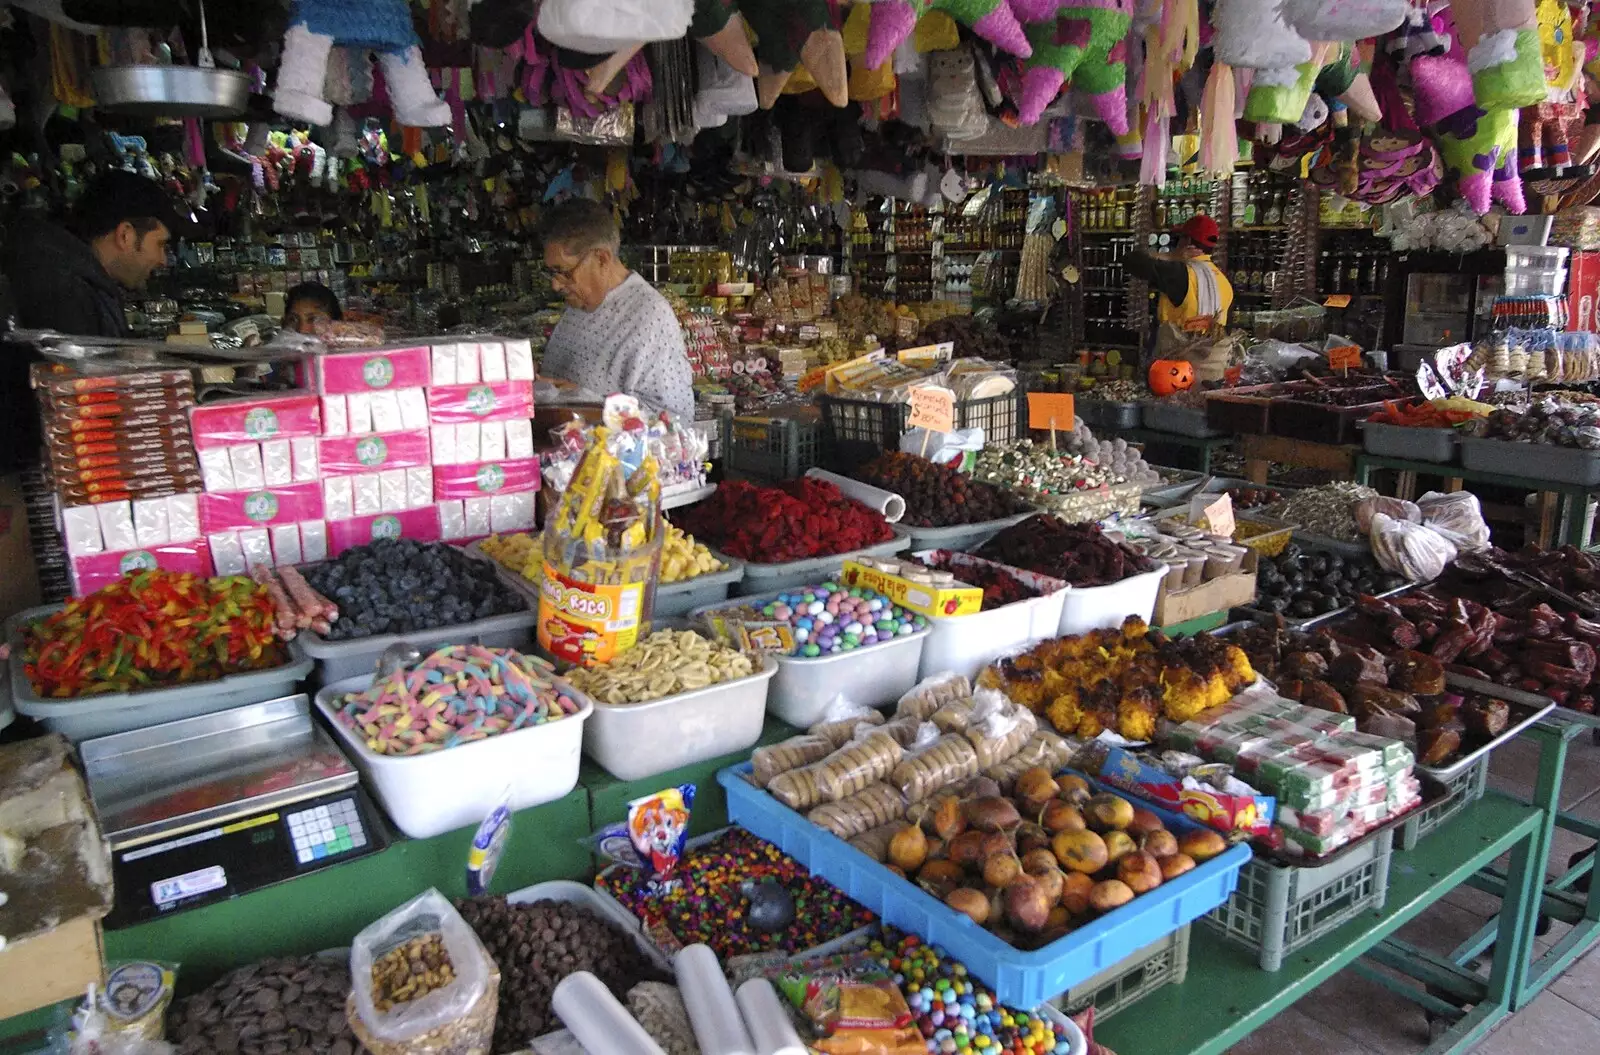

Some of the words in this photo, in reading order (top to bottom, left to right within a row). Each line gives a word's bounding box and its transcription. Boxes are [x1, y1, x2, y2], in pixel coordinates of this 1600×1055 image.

[863, 571, 885, 593] Rosa
[887, 579, 895, 597] la
[896, 583, 908, 600] de
